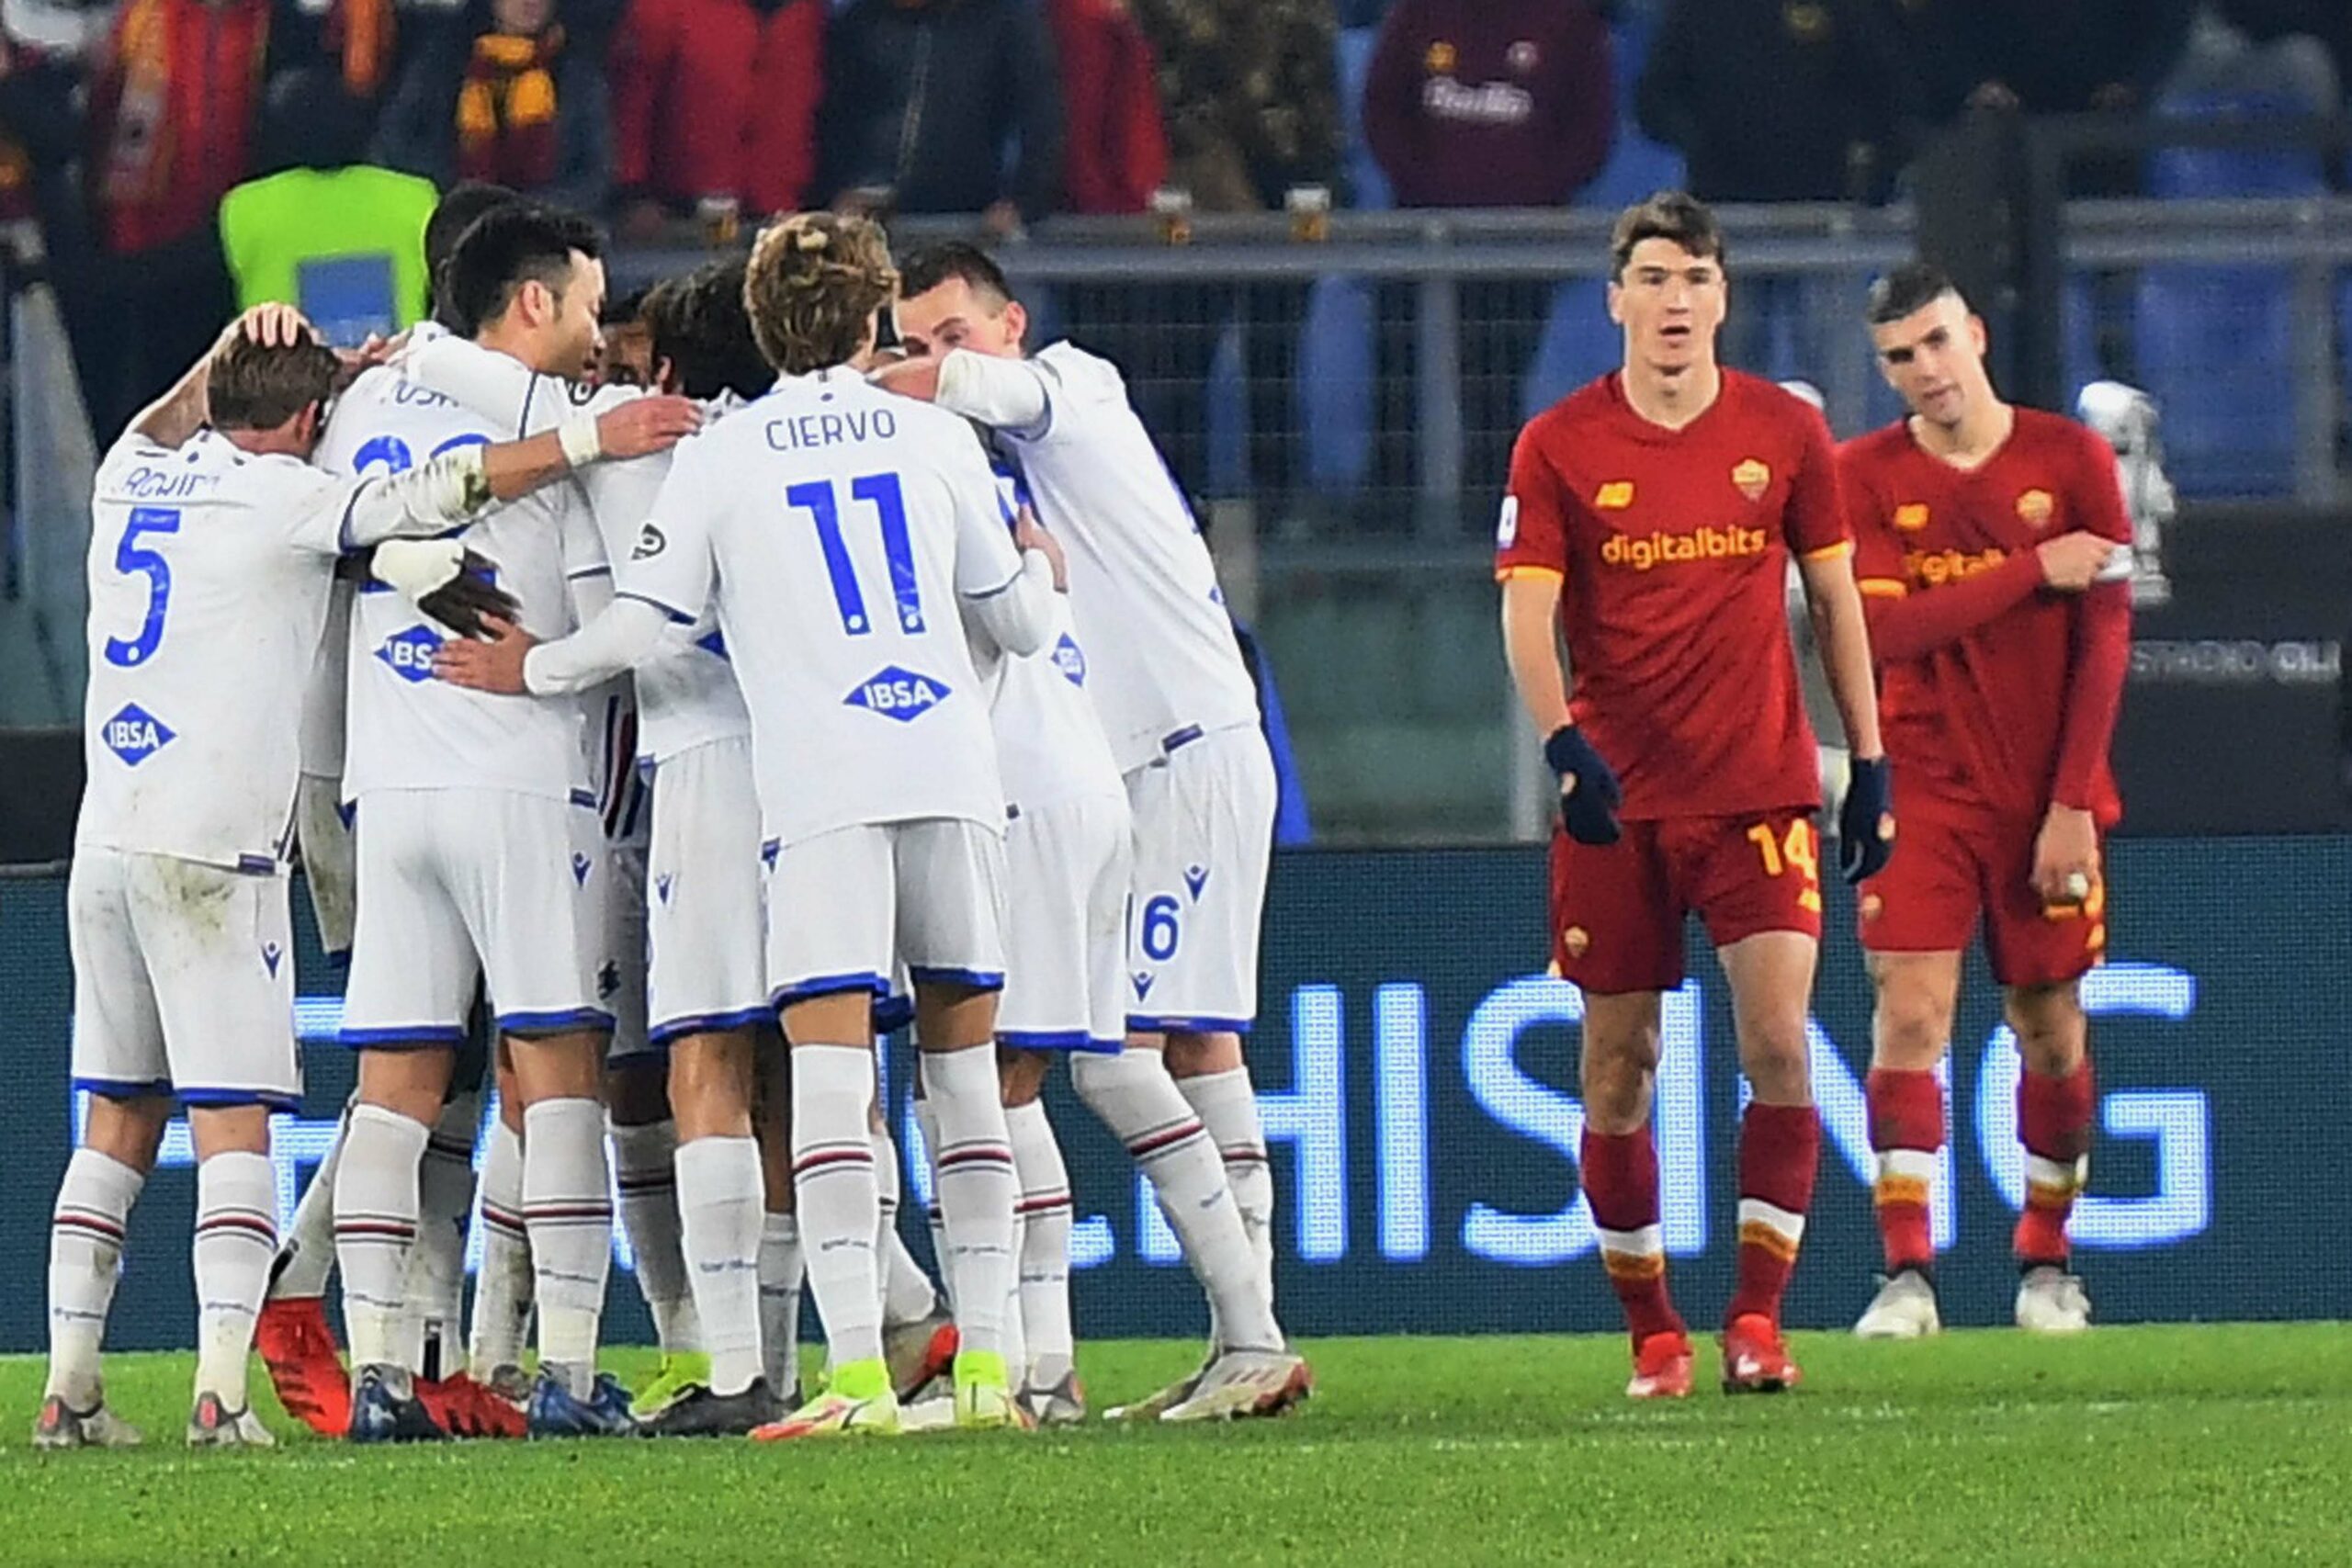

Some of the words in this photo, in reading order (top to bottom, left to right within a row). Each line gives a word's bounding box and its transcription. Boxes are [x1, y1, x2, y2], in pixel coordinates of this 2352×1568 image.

[766, 409, 896, 451] CIERVO
[786, 472, 926, 635] 11
[1601, 525, 1766, 570] digitalbits
[105, 507, 180, 667] 5
[386, 640, 435, 671] IBS
[864, 679, 937, 708] IBSA
[108, 720, 160, 750] IBSA
[1747, 818, 1817, 880] 14
